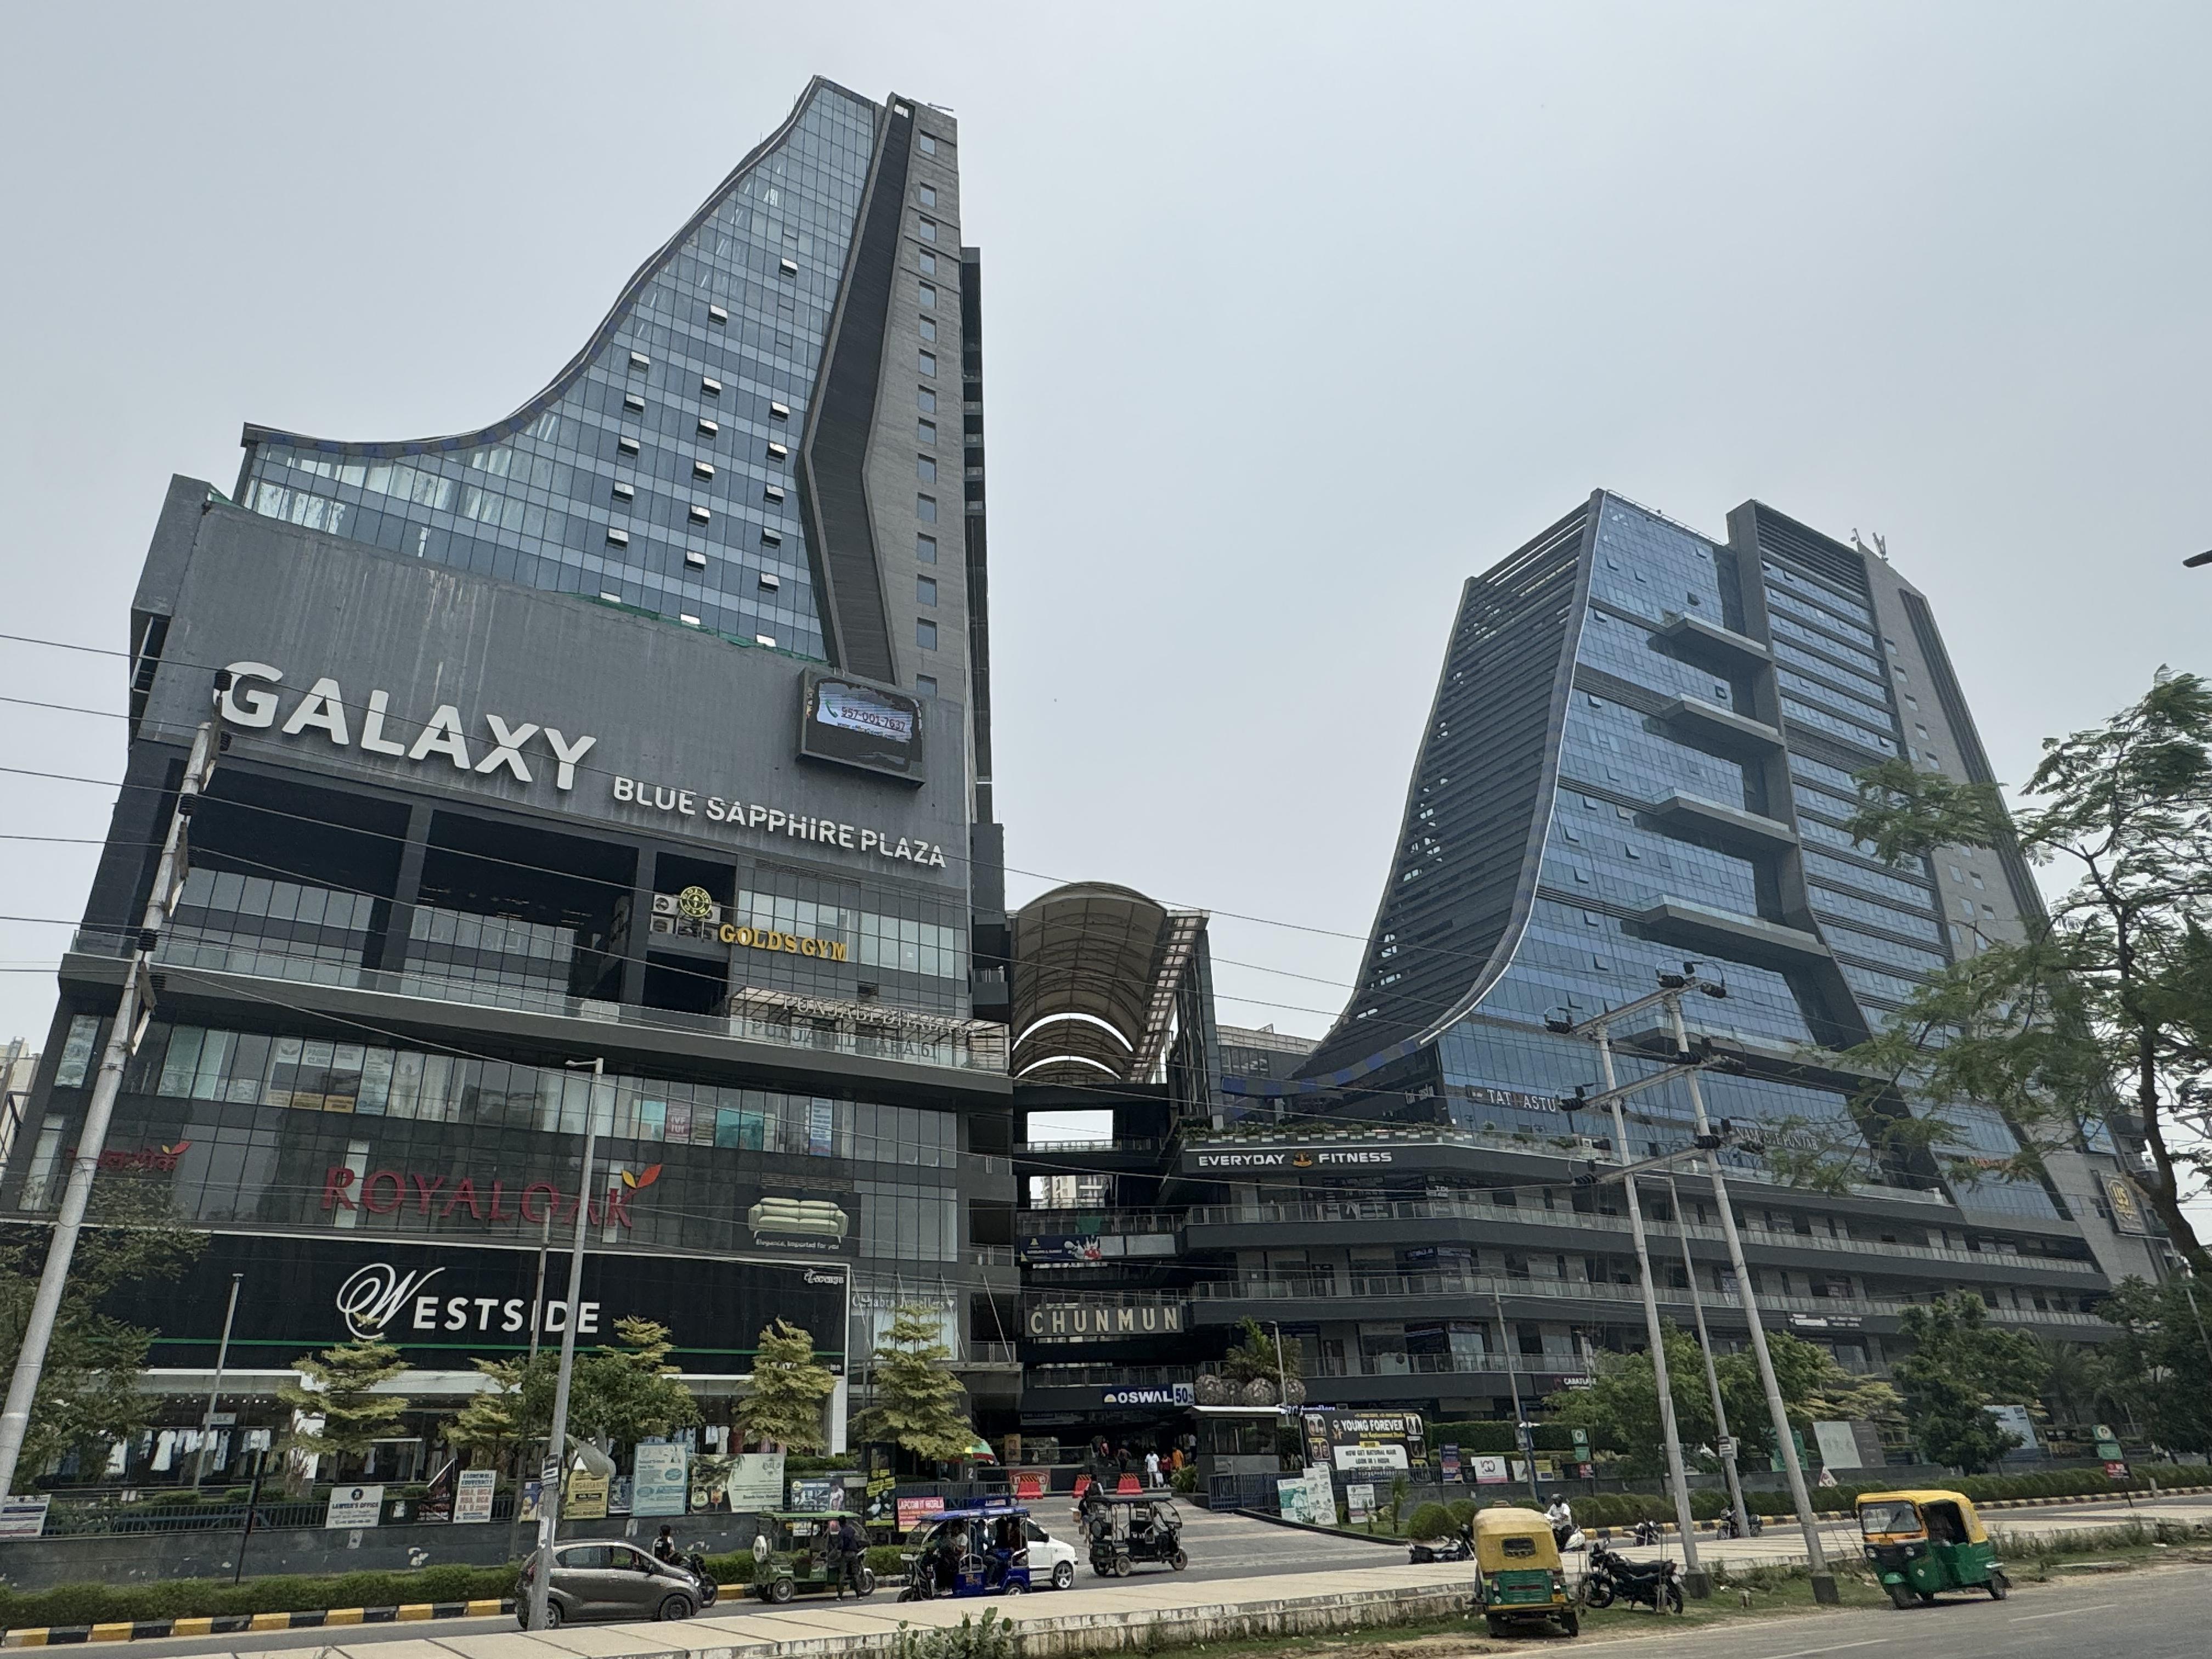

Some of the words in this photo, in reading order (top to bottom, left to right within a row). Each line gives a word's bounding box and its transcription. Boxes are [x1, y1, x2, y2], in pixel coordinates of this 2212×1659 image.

[213, 662, 597, 790] GALAXY
[613, 776, 696, 816] BLUE
[706, 797, 855, 849] SAPPHIRE
[861, 831, 946, 868] PLAZA
[801, 938, 847, 961] GYM
[1199, 1154, 1285, 1167] EVERYDAY
[1319, 1152, 1392, 1164] FITNESS
[322, 1167, 638, 1228] ROYALOAK
[336, 1263, 601, 1339] WESTSIDE
[1030, 1307, 1178, 1334] CHUNMUN
[1118, 1390, 1173, 1403] OSWAL
[1341, 1419, 1369, 1432] YOUNG
[1370, 1419, 1404, 1431] FOREVER
[968, 1466, 974, 1479] 2
